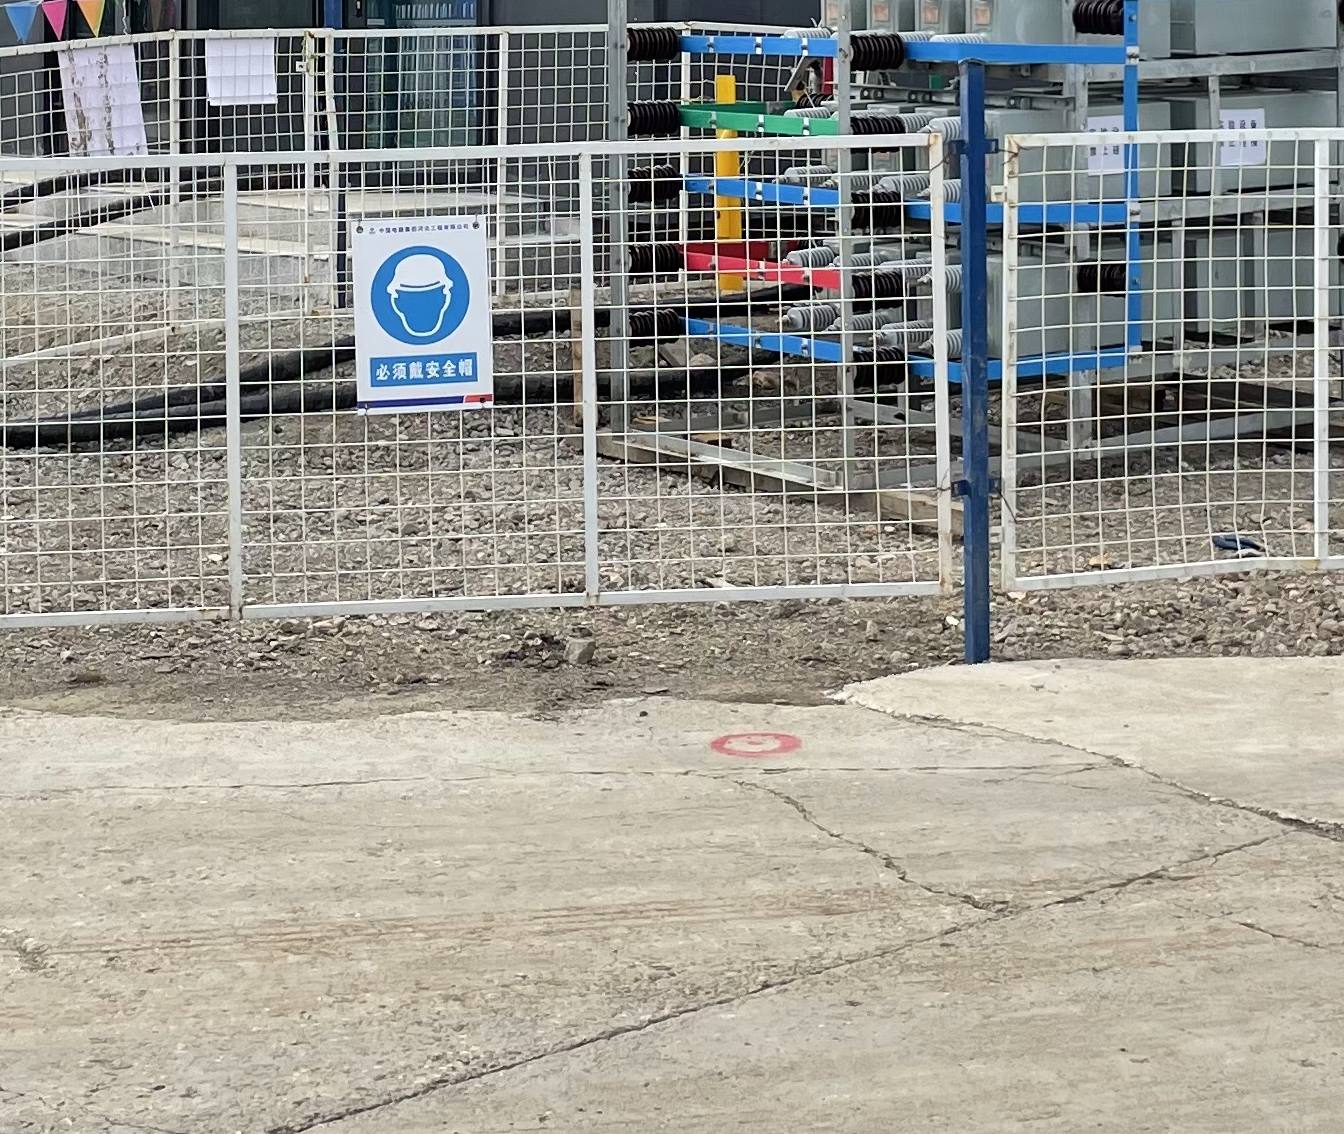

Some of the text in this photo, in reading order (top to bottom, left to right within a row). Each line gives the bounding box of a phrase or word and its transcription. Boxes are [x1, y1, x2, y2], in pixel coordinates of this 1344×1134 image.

[376, 358, 473, 381] 必须戴安全帽
